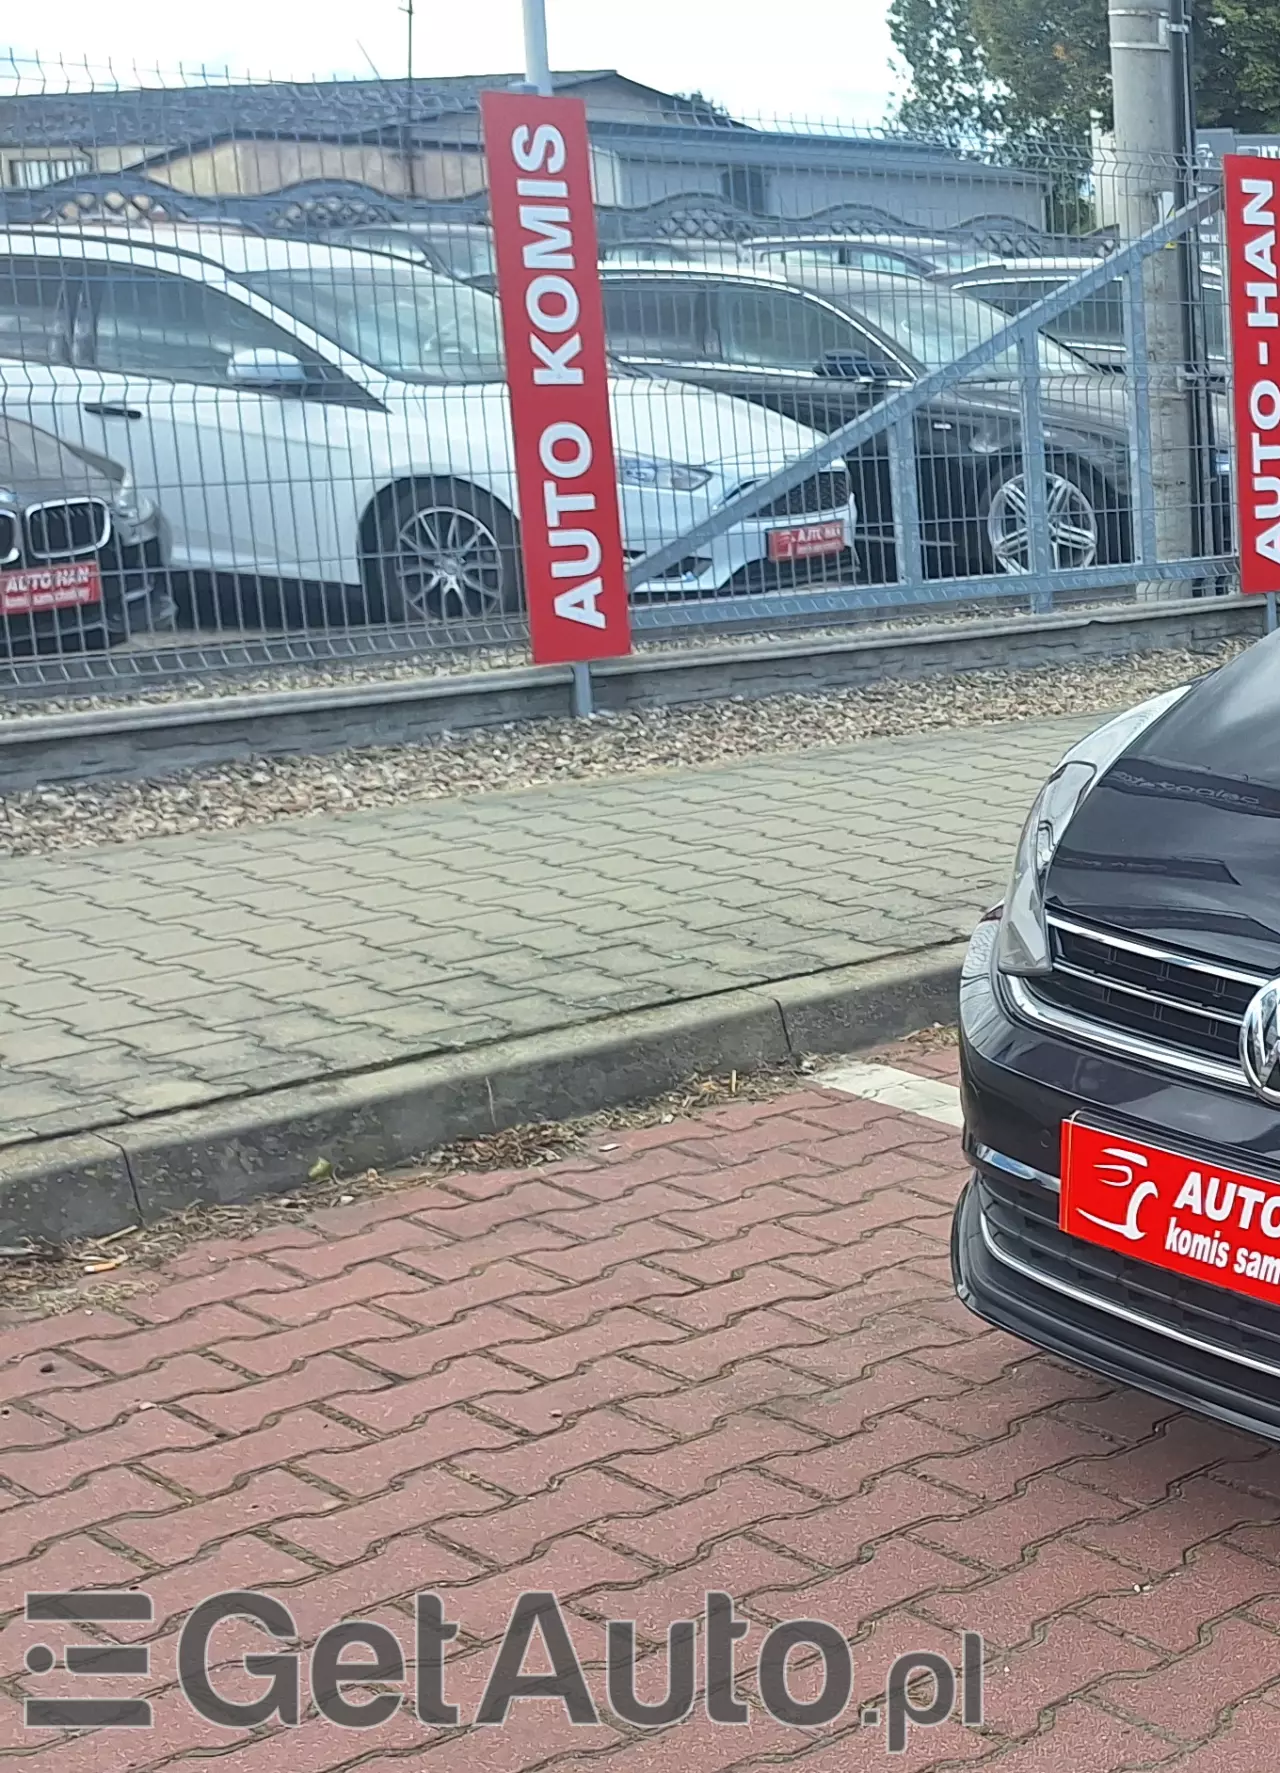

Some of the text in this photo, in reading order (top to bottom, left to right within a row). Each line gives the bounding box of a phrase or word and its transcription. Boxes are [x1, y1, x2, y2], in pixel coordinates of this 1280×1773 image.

[511, 124, 606, 629] AUTO KOMIS
[1164, 1216, 1231, 1269] komis
